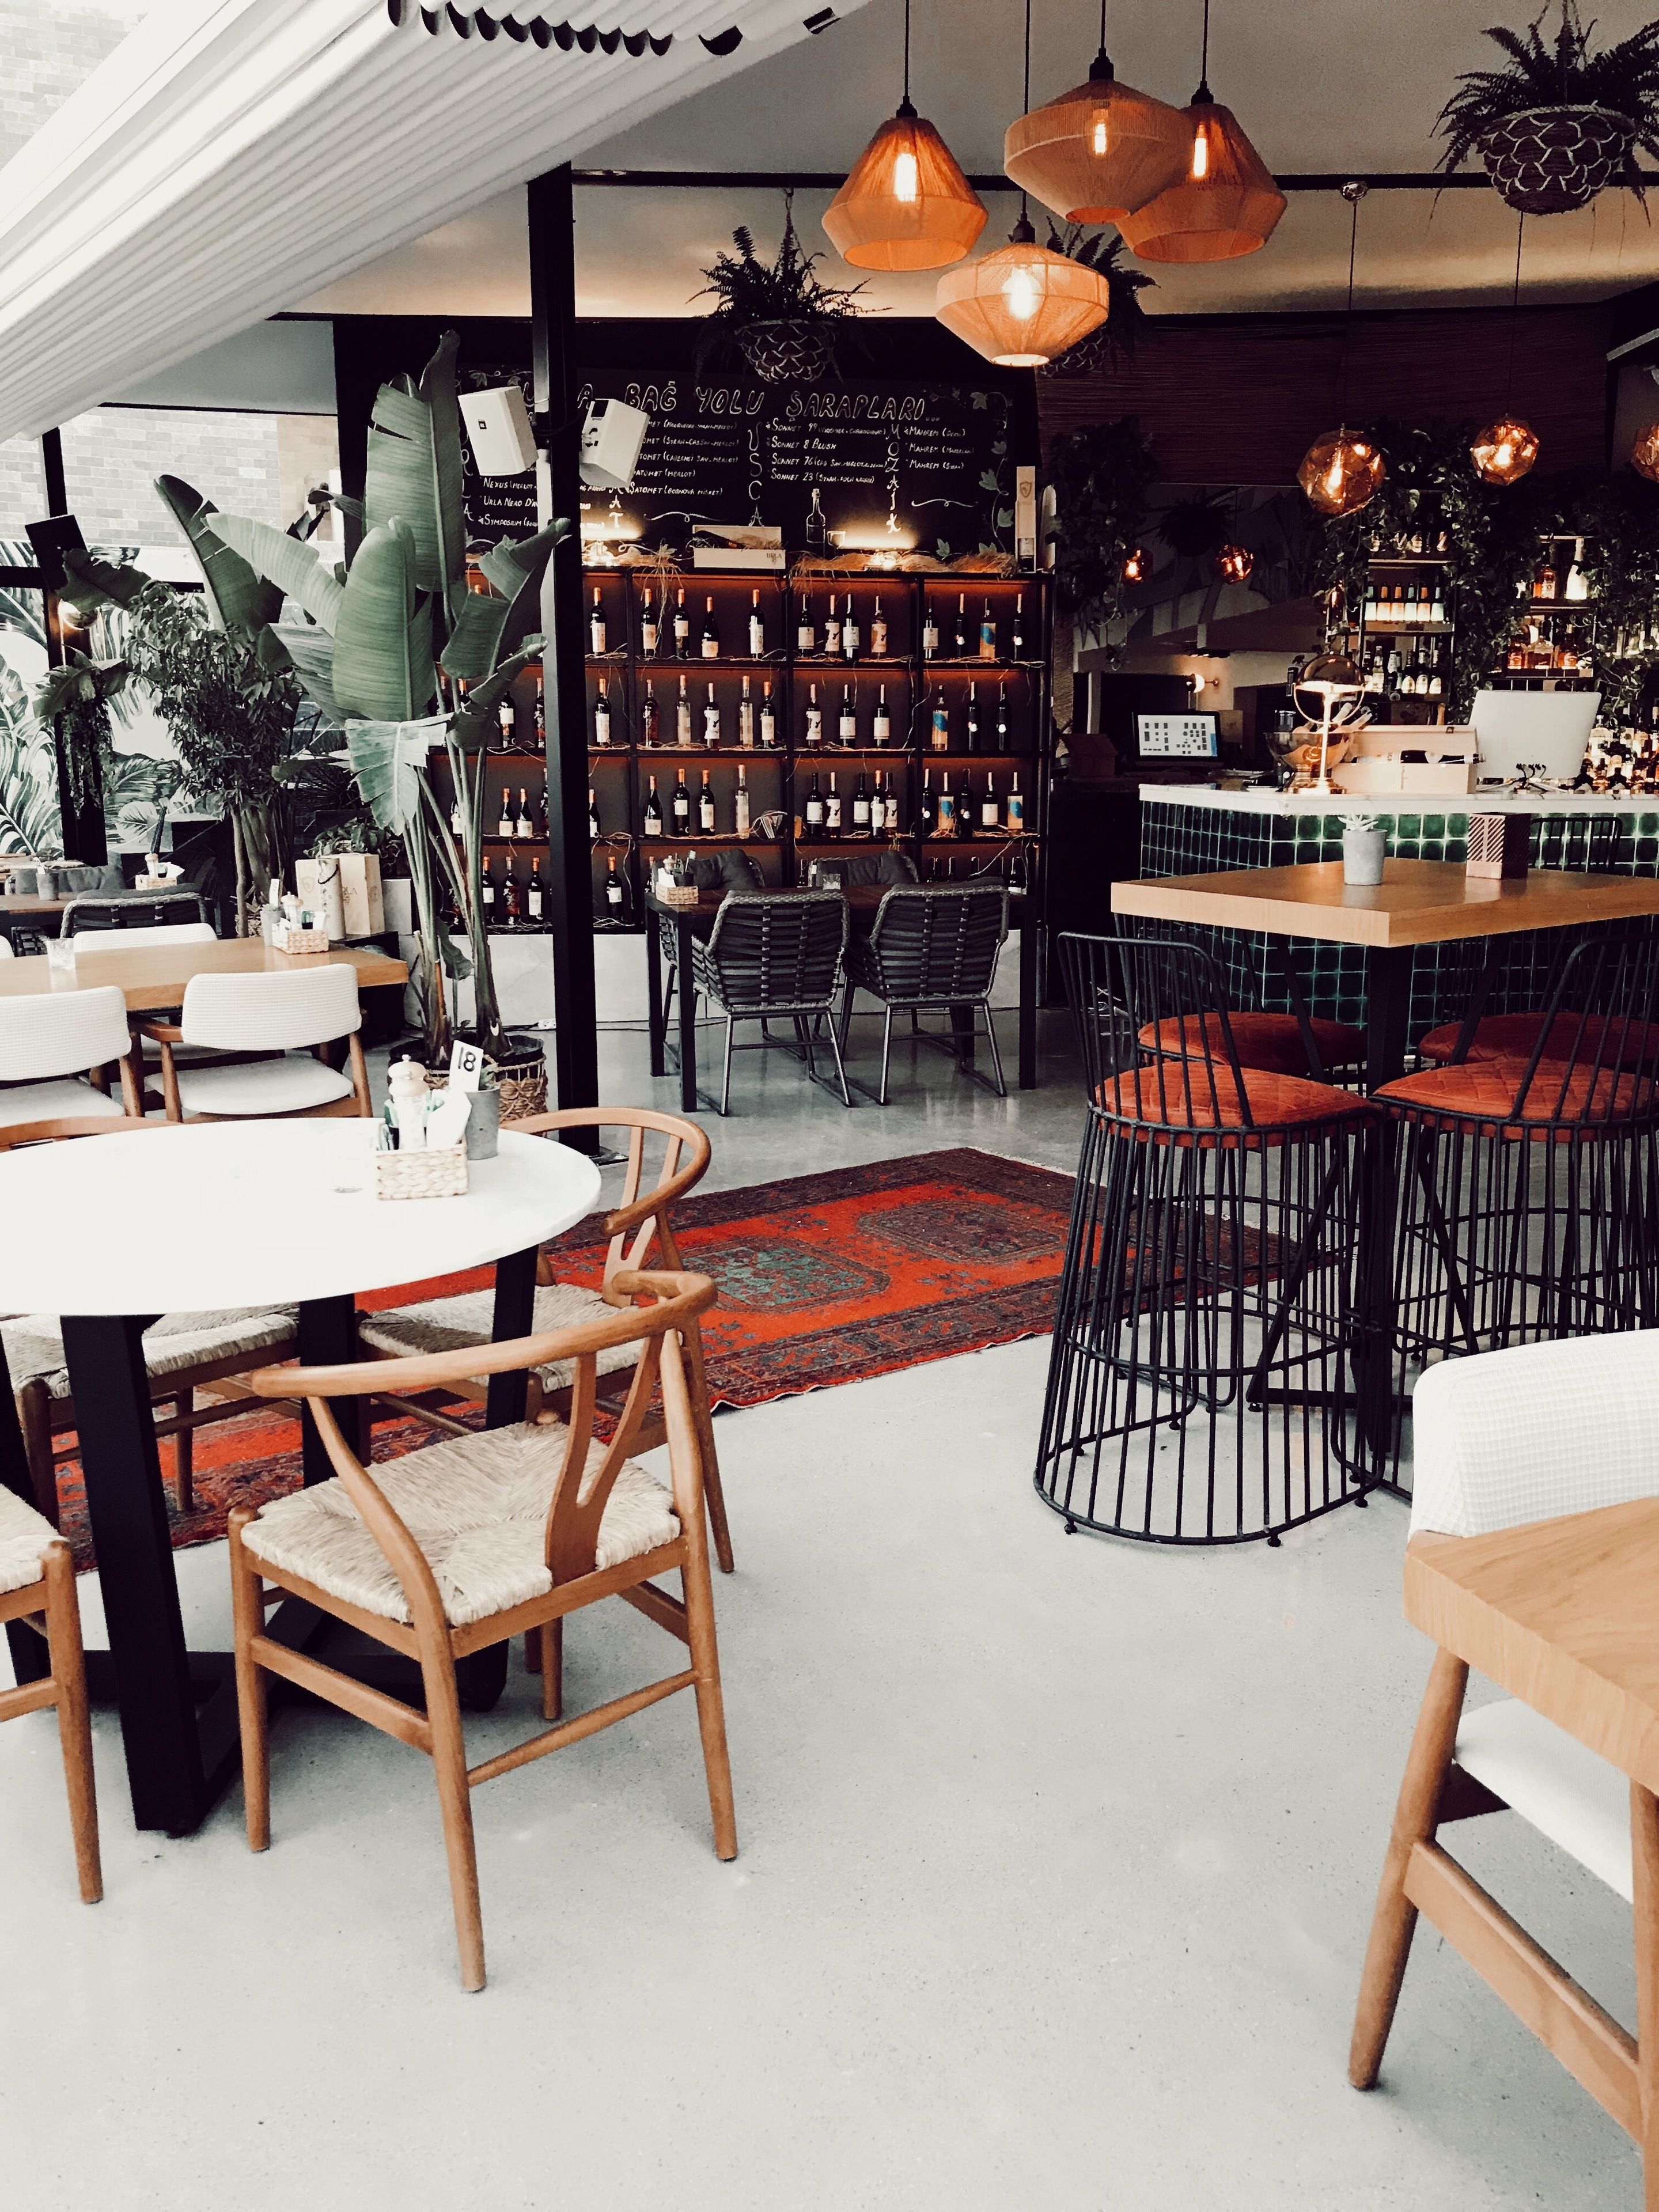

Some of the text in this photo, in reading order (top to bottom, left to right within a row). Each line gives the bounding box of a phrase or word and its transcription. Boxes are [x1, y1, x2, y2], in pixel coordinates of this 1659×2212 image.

[695, 387, 765, 415] YOLU
[772, 418, 802, 431] SONNET
[909, 426, 940, 436] MAHREM
[771, 435, 836, 449] SONNET 8 BLUSH
[771, 452, 800, 465] SONNET
[909, 459, 940, 469] MAHREM
[771, 468, 800, 480] SONNET
[802, 472, 813, 482] 23
[483, 477, 508, 488] NEXUS
[483, 495, 502, 506] URLA
[504, 497, 522, 507] NERO
[457, 1047, 476, 1073] 18
